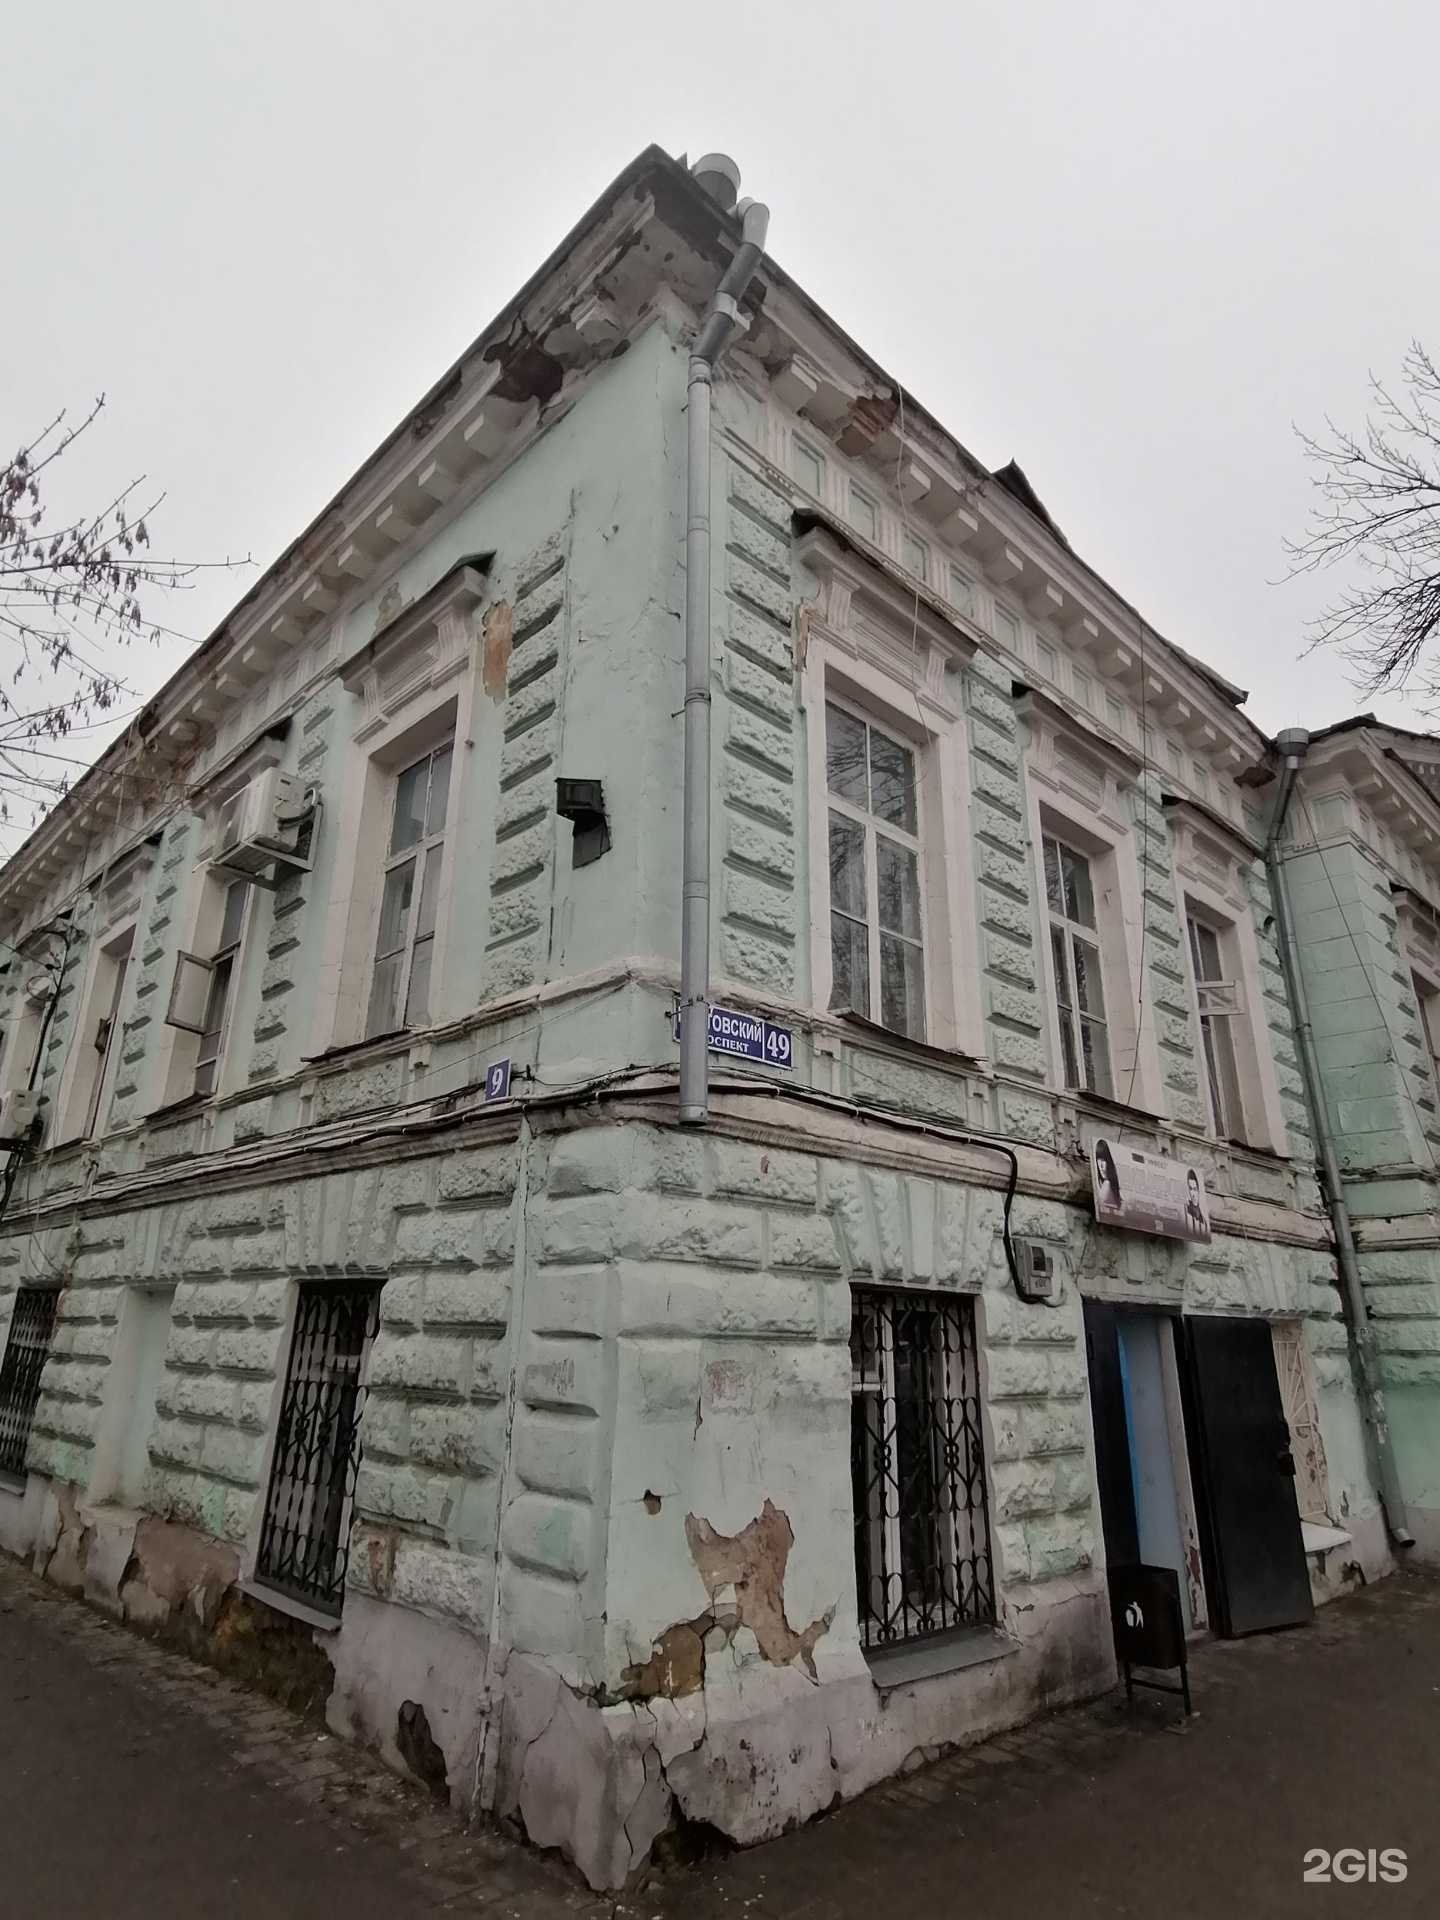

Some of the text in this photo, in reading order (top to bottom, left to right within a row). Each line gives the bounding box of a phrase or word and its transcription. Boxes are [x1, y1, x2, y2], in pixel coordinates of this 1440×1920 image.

[678, 1006, 762, 1043] ТОВСКИЙ
[707, 1034, 750, 1053] ОСПЕКТ
[766, 1030, 790, 1060] 49
[491, 1067, 504, 1096] 9
